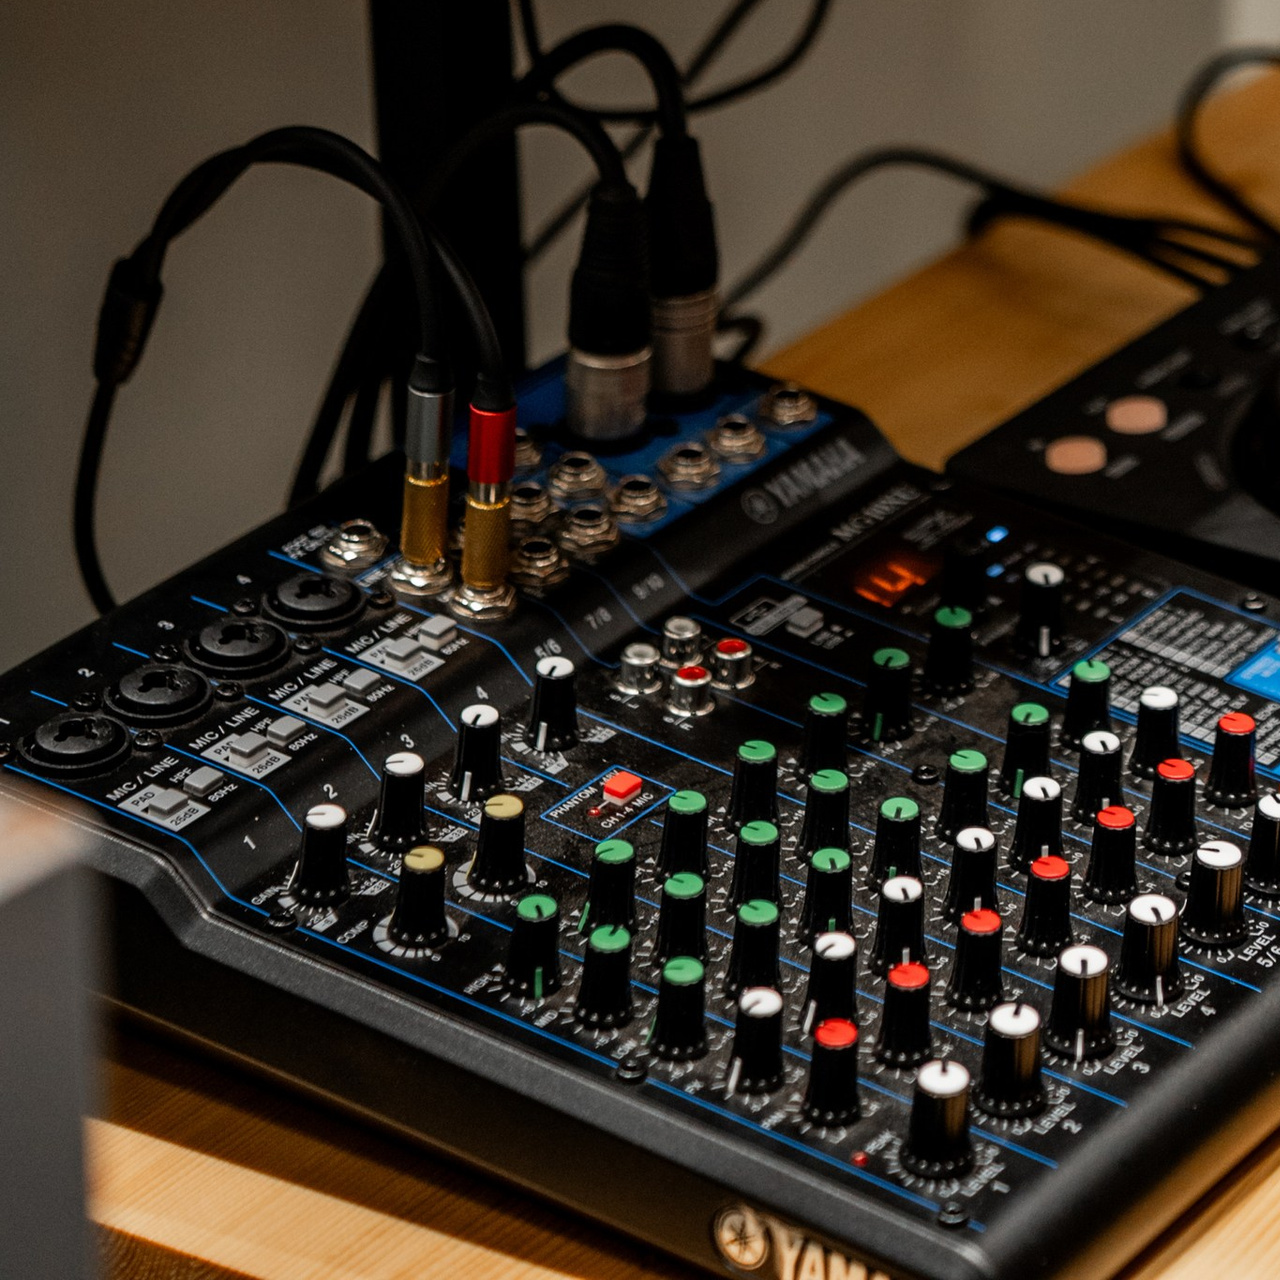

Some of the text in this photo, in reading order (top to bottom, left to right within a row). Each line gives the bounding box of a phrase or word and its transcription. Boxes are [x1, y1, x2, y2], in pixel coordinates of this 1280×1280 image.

[344, 634, 375, 654] MIC
[378, 612, 413, 634] LINE
[533, 638, 562, 659] 5/6
[77, 667, 96, 679] 2
[268, 682, 299, 702] MIC
[304, 658, 338, 680] LINE
[328, 669, 351, 685] HPF
[475, 685, 489, 700] 4
[250, 717, 273, 733] HPF
[331, 705, 360, 725] 26dB
[188, 730, 220, 751] MIC
[225, 706, 261, 728] LINE
[288, 732, 318, 752] 80Hz
[400, 733, 415, 749] 3
[252, 755, 281, 775] 26dB
[105, 781, 137, 802] MIC
[143, 756, 180, 779] LINE
[169, 767, 193, 784] HPF
[131, 791, 155, 807] PAD
[207, 782, 239, 803] 80Hz
[323, 783, 338, 799] 2
[549, 786, 599, 819] PHANTOM
[600, 792, 654, 829] CH 1-4 MIC
[170, 807, 200, 827] 26dB
[243, 835, 257, 851] 1
[336, 919, 369, 945] COMP
[1237, 933, 1277, 962] LEVEL
[1191, 974, 1205, 984] 10
[1170, 989, 1211, 1018] LEVEL
[1200, 1005, 1216, 1017] 4
[533, 1010, 559, 1029] MID
[1103, 1044, 1145, 1076] LEVEL
[1132, 1060, 1150, 1074] 3
[1033, 1102, 1077, 1135] LEVEL
[1061, 1119, 1083, 1134] 2
[767, 1219, 893, 1280] YAM
